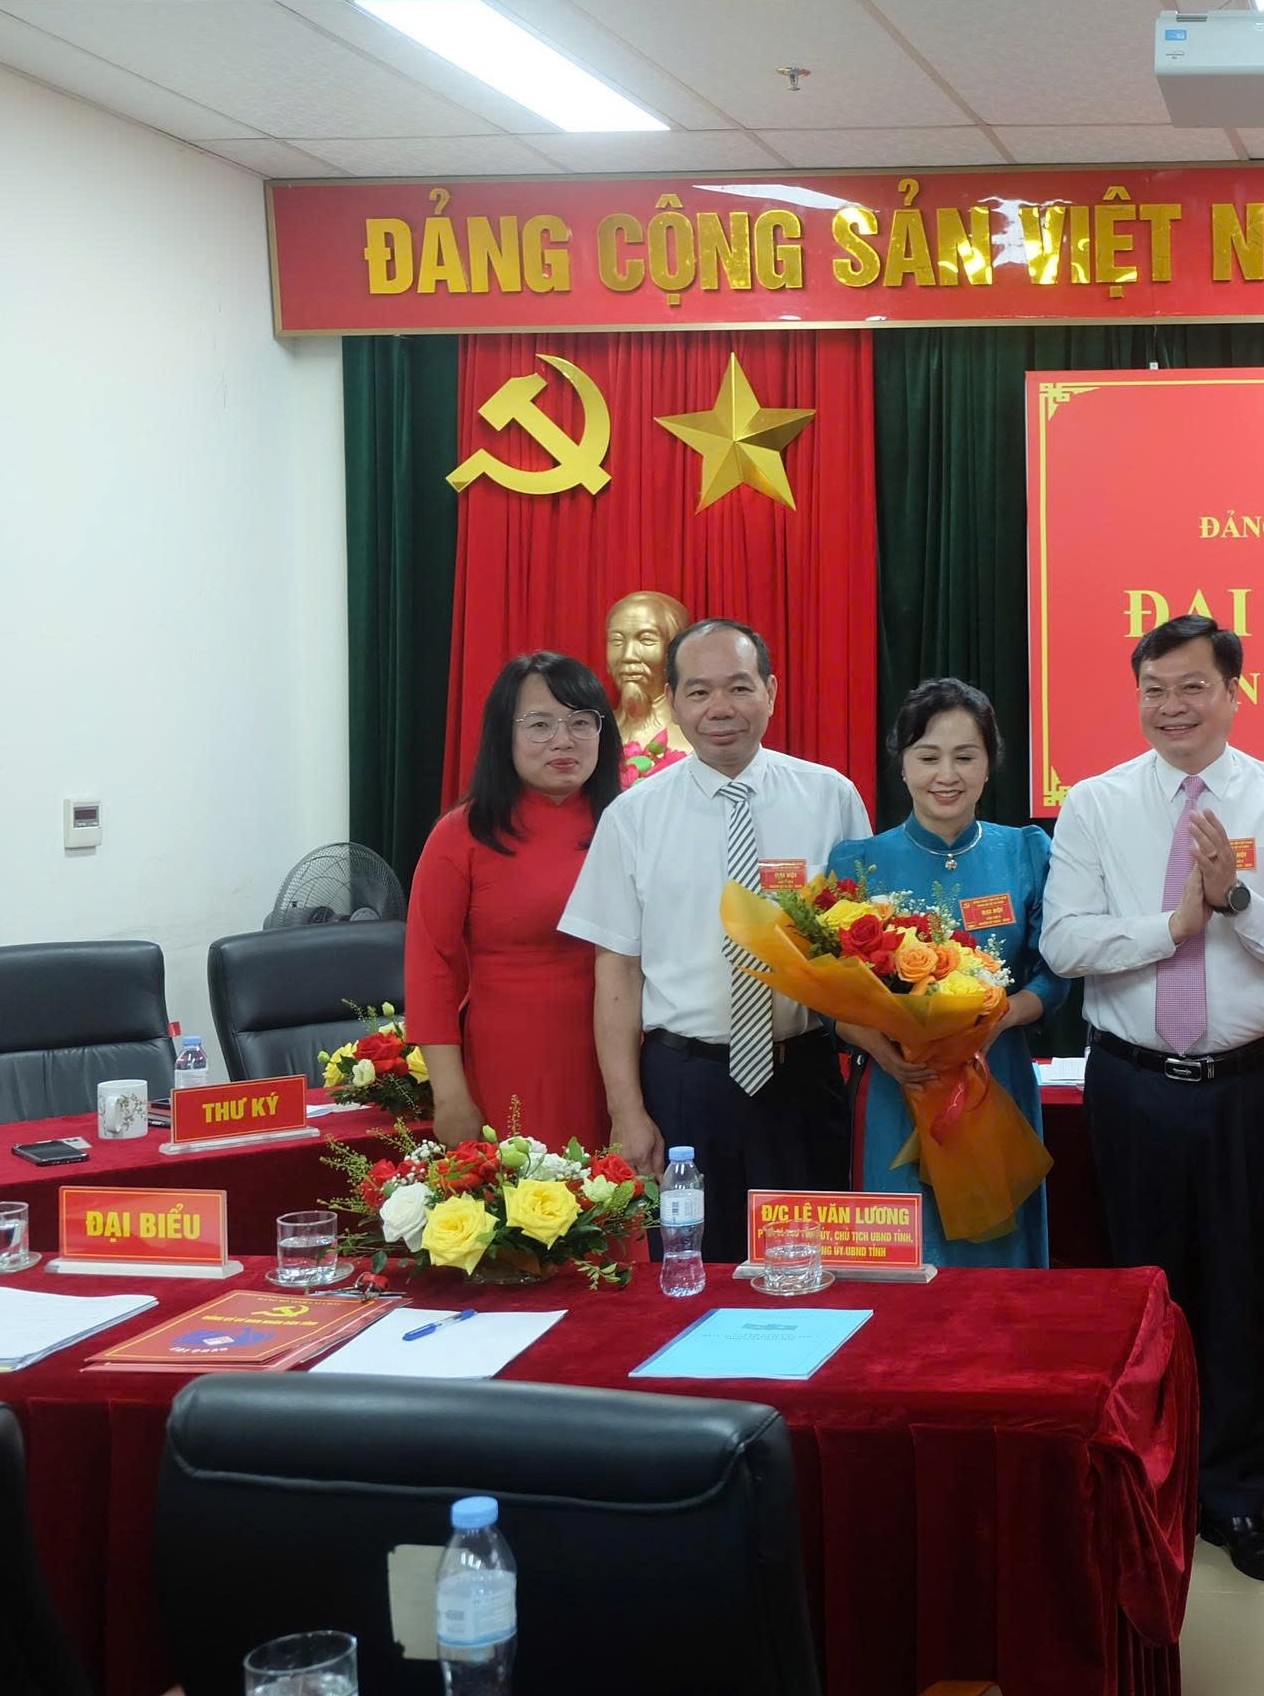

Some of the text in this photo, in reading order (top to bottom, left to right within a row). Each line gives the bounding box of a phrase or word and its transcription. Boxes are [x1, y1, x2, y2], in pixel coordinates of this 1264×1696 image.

[364, 188, 571, 295] ĐẢNG
[597, 193, 803, 306] CỘNG
[832, 178, 992, 288] SẢN
[1021, 186, 1182, 298] VIỆT
[202, 1092, 279, 1123] THƯ KÝ
[86, 1203, 201, 1242] ĐẠI BIỂU
[761, 1202, 910, 1225] Đ/C LÊ VĂN LƯƠNG
